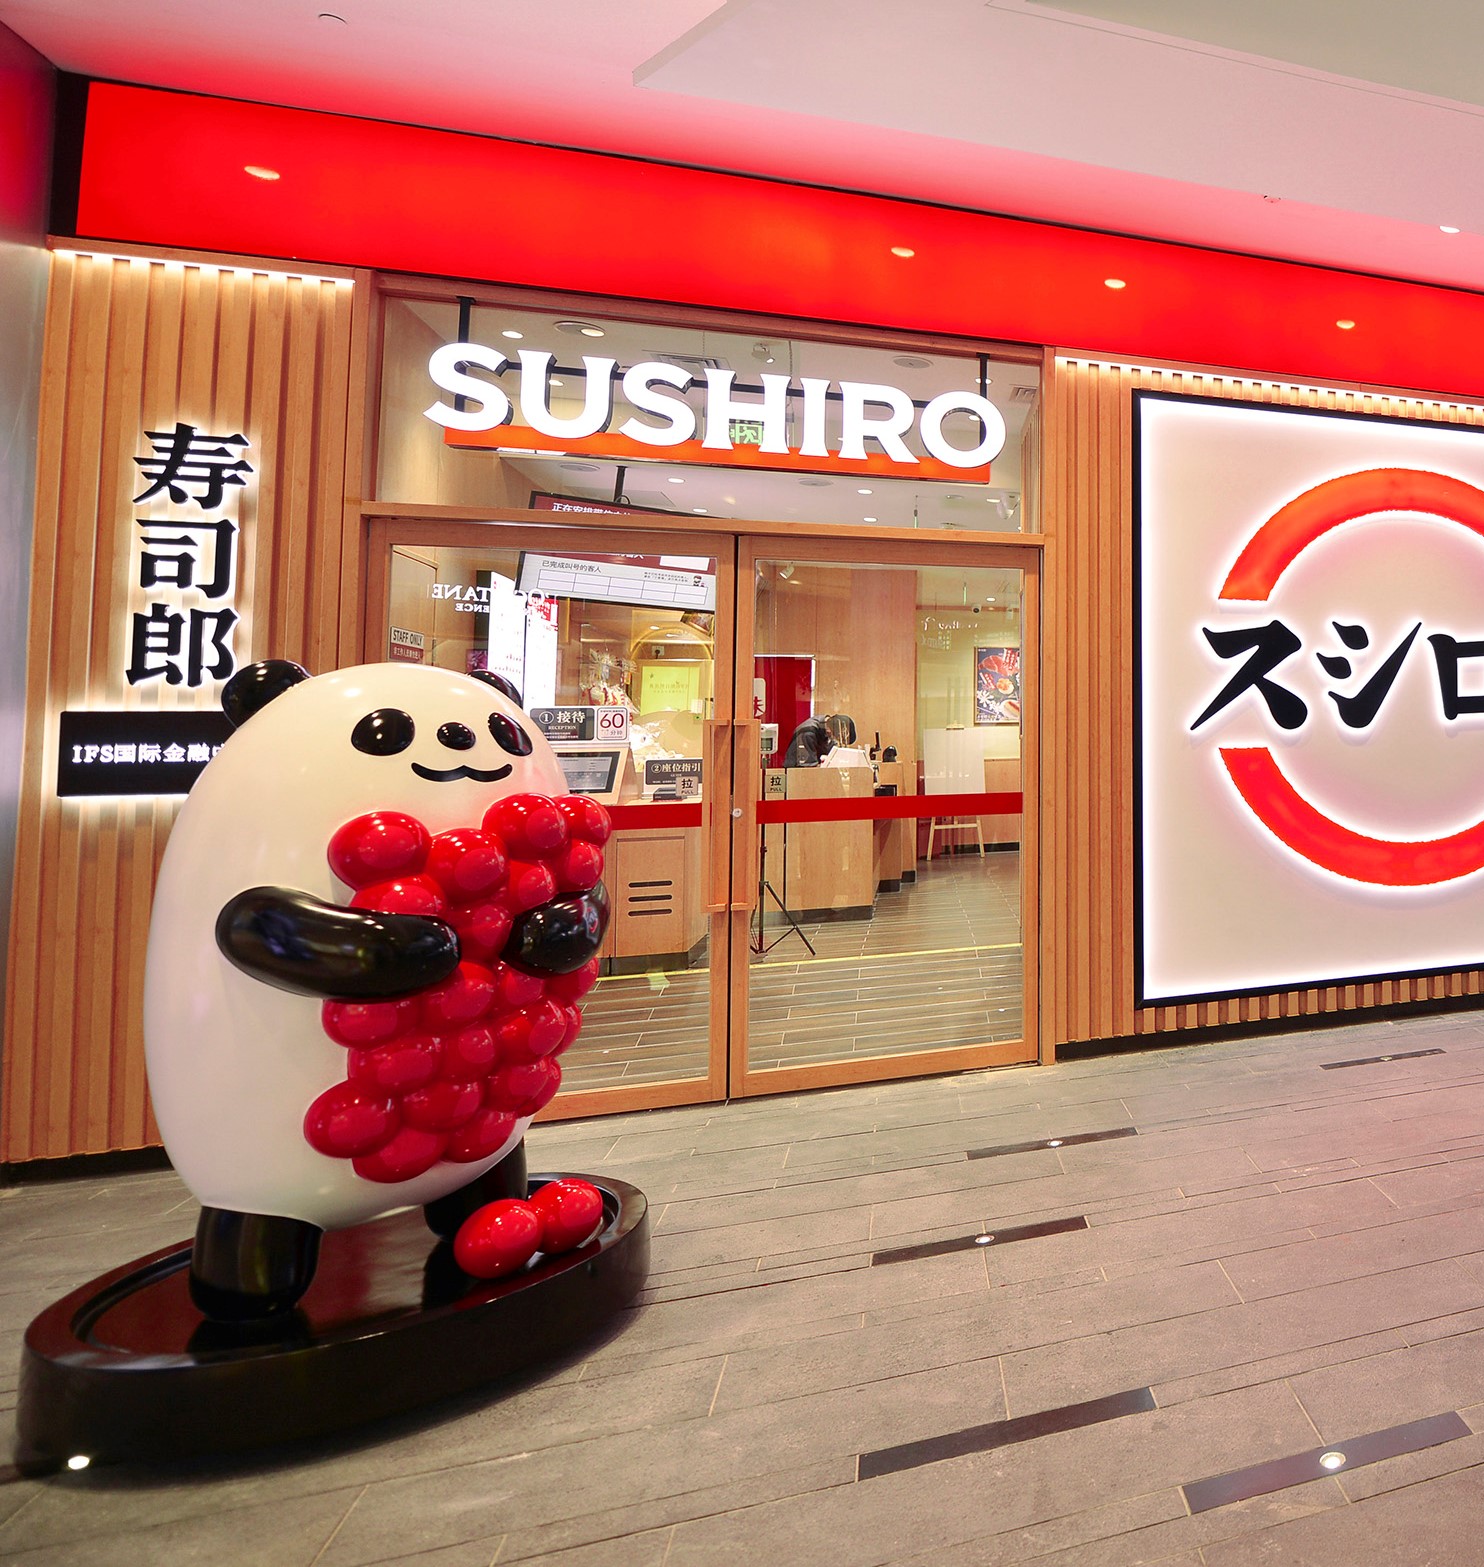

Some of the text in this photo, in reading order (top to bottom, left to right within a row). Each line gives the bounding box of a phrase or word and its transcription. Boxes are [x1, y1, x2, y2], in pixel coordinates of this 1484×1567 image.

[423, 341, 1006, 468] SUSHIRO
[126, 422, 254, 687] 寿司郎
[542, 560, 602, 574] 已完成叫号的客人
[393, 630, 409, 644] STAFF
[600, 713, 625, 729] 60
[681, 778, 694, 789] 拉
[770, 777, 781, 787] 拉
